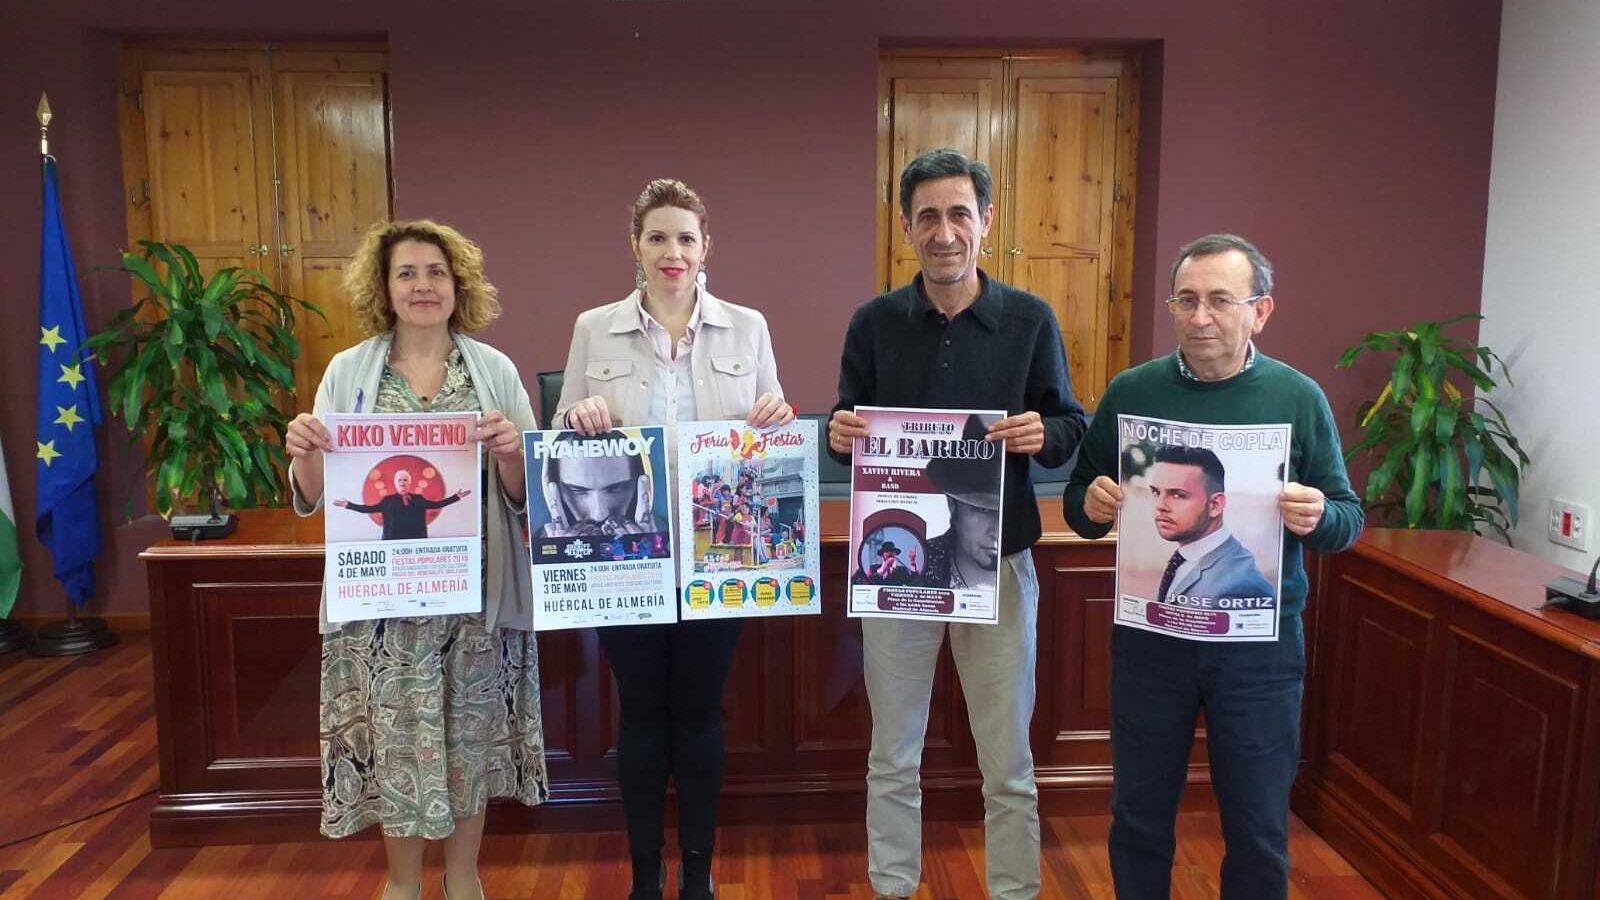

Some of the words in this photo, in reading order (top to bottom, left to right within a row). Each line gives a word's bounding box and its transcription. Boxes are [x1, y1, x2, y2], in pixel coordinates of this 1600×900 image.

[336, 424, 385, 447] KIKO
[388, 423, 467, 446] VENENO
[902, 421, 955, 434] TRIBUTO
[1122, 420, 1184, 447] NOCHE
[1189, 431, 1216, 449] DE
[1219, 431, 1284, 451] COPLA
[690, 430, 730, 454] Feria
[757, 429, 806, 453] Fiestas
[862, 436, 892, 456] EL
[897, 438, 995, 460] BARRIO
[862, 467, 889, 475] XAVIVI
[890, 468, 921, 477] RIVERA
[337, 547, 387, 566] SÁBADO
[337, 568, 345, 579] 4
[346, 568, 358, 579] DE
[359, 566, 387, 579] MAYO
[543, 569, 587, 582] VIERNES
[397, 582, 413, 596] DE
[416, 578, 469, 595] ALMERÍA
[543, 584, 550, 594] 3
[551, 583, 562, 593] DE
[563, 582, 588, 593] MAYO
[598, 597, 613, 609] DE
[616, 593, 665, 608] ALMERÍA
[1217, 597, 1274, 609] ORTIZ
